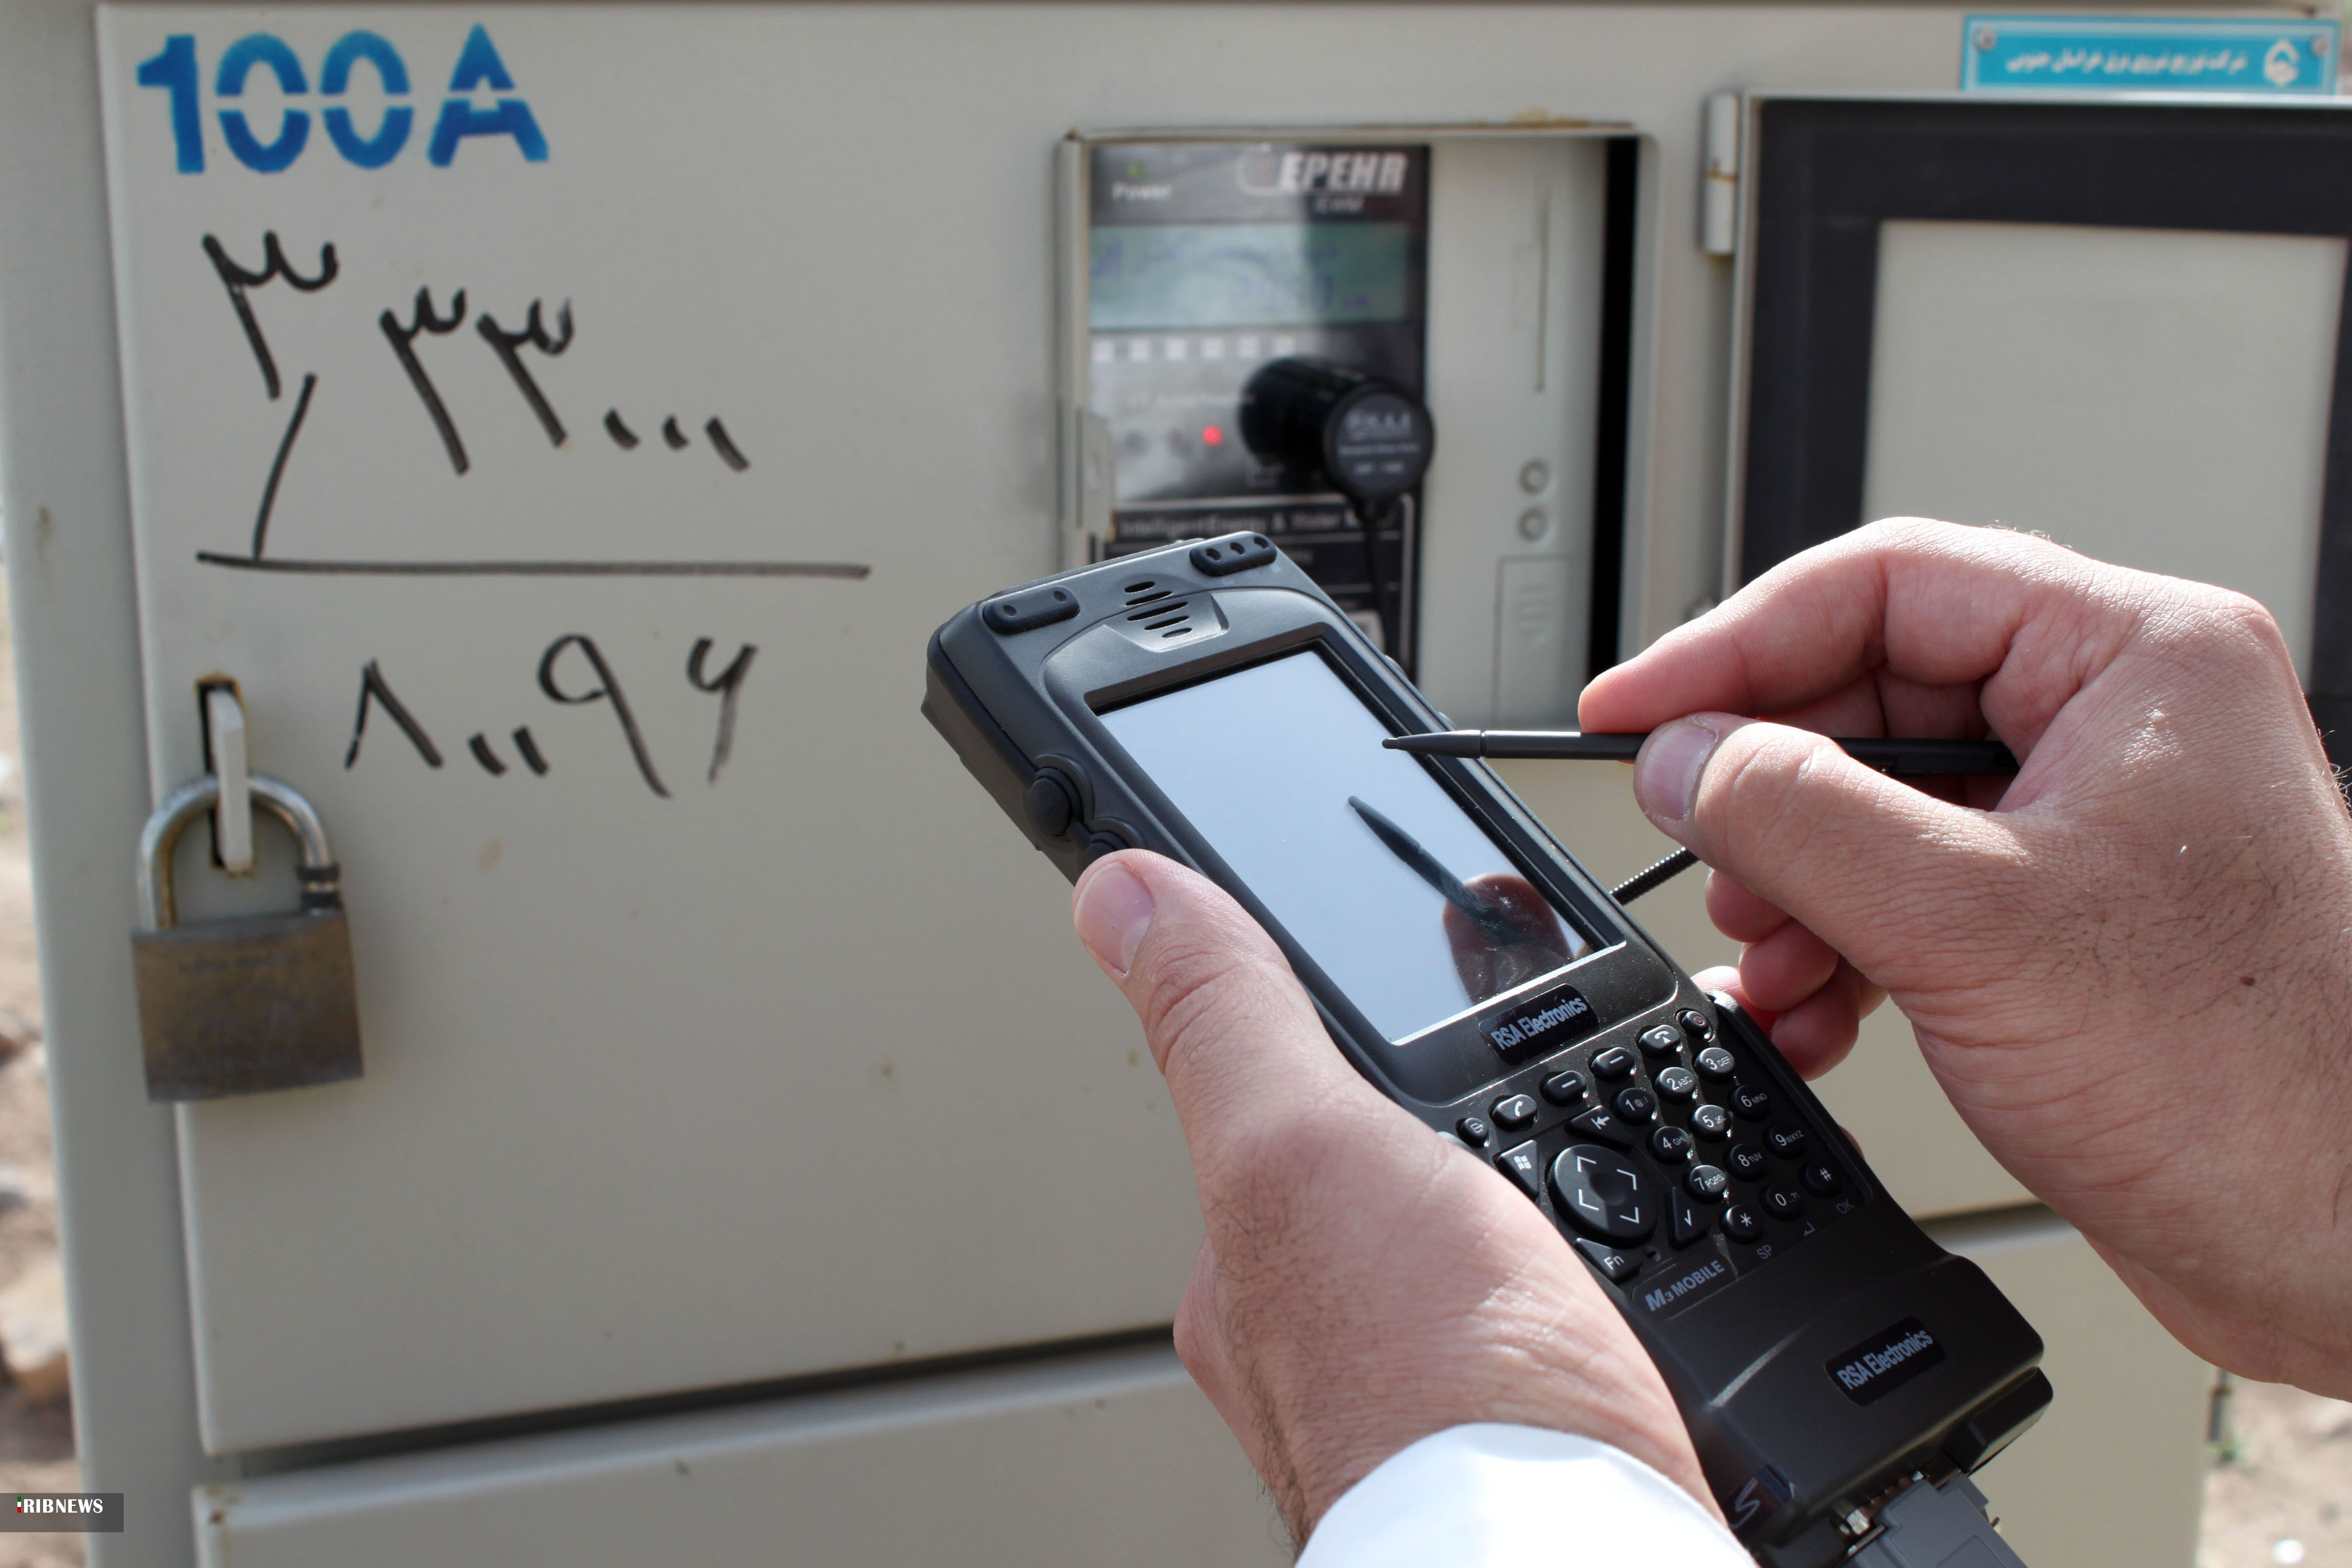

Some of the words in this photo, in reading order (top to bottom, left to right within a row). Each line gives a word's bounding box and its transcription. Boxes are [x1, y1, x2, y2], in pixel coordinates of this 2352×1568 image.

[136, 23, 548, 173] 100A
[1490, 1023, 1527, 1050] RSA
[1517, 997, 1587, 1037] Electronics
[1705, 1058, 1718, 1070] 3
[1716, 1055, 1731, 1067] DEF
[1667, 1077, 1680, 1091] 2
[1677, 1075, 1692, 1088] ABC
[1625, 1099, 1636, 1111] 1
[1740, 1095, 1752, 1108] 6
[1752, 1092, 1768, 1105] MNO
[1701, 1114, 1714, 1128] 5
[1714, 1114, 1727, 1124] JKL
[1662, 1136, 1673, 1149] 4
[1673, 1134, 1687, 1146] GHI
[1774, 1133, 1787, 1147] 9
[1786, 1129, 1805, 1144] WXYZ
[1737, 1154, 1750, 1167] 8
[1748, 1151, 1762, 1163] TUV
[1694, 1177, 1706, 1191] 7
[1704, 1173, 1725, 1188] PQRS
[1775, 1193, 1787, 1206] 0
[1836, 1199, 1855, 1214] OK
[1756, 1244, 1772, 1260] SP
[1603, 1255, 1624, 1270] Fn
[1670, 1260, 1726, 1297] MOBILE
[1836, 1361, 1875, 1390] RSA
[1862, 1329, 1934, 1375] Electronics
